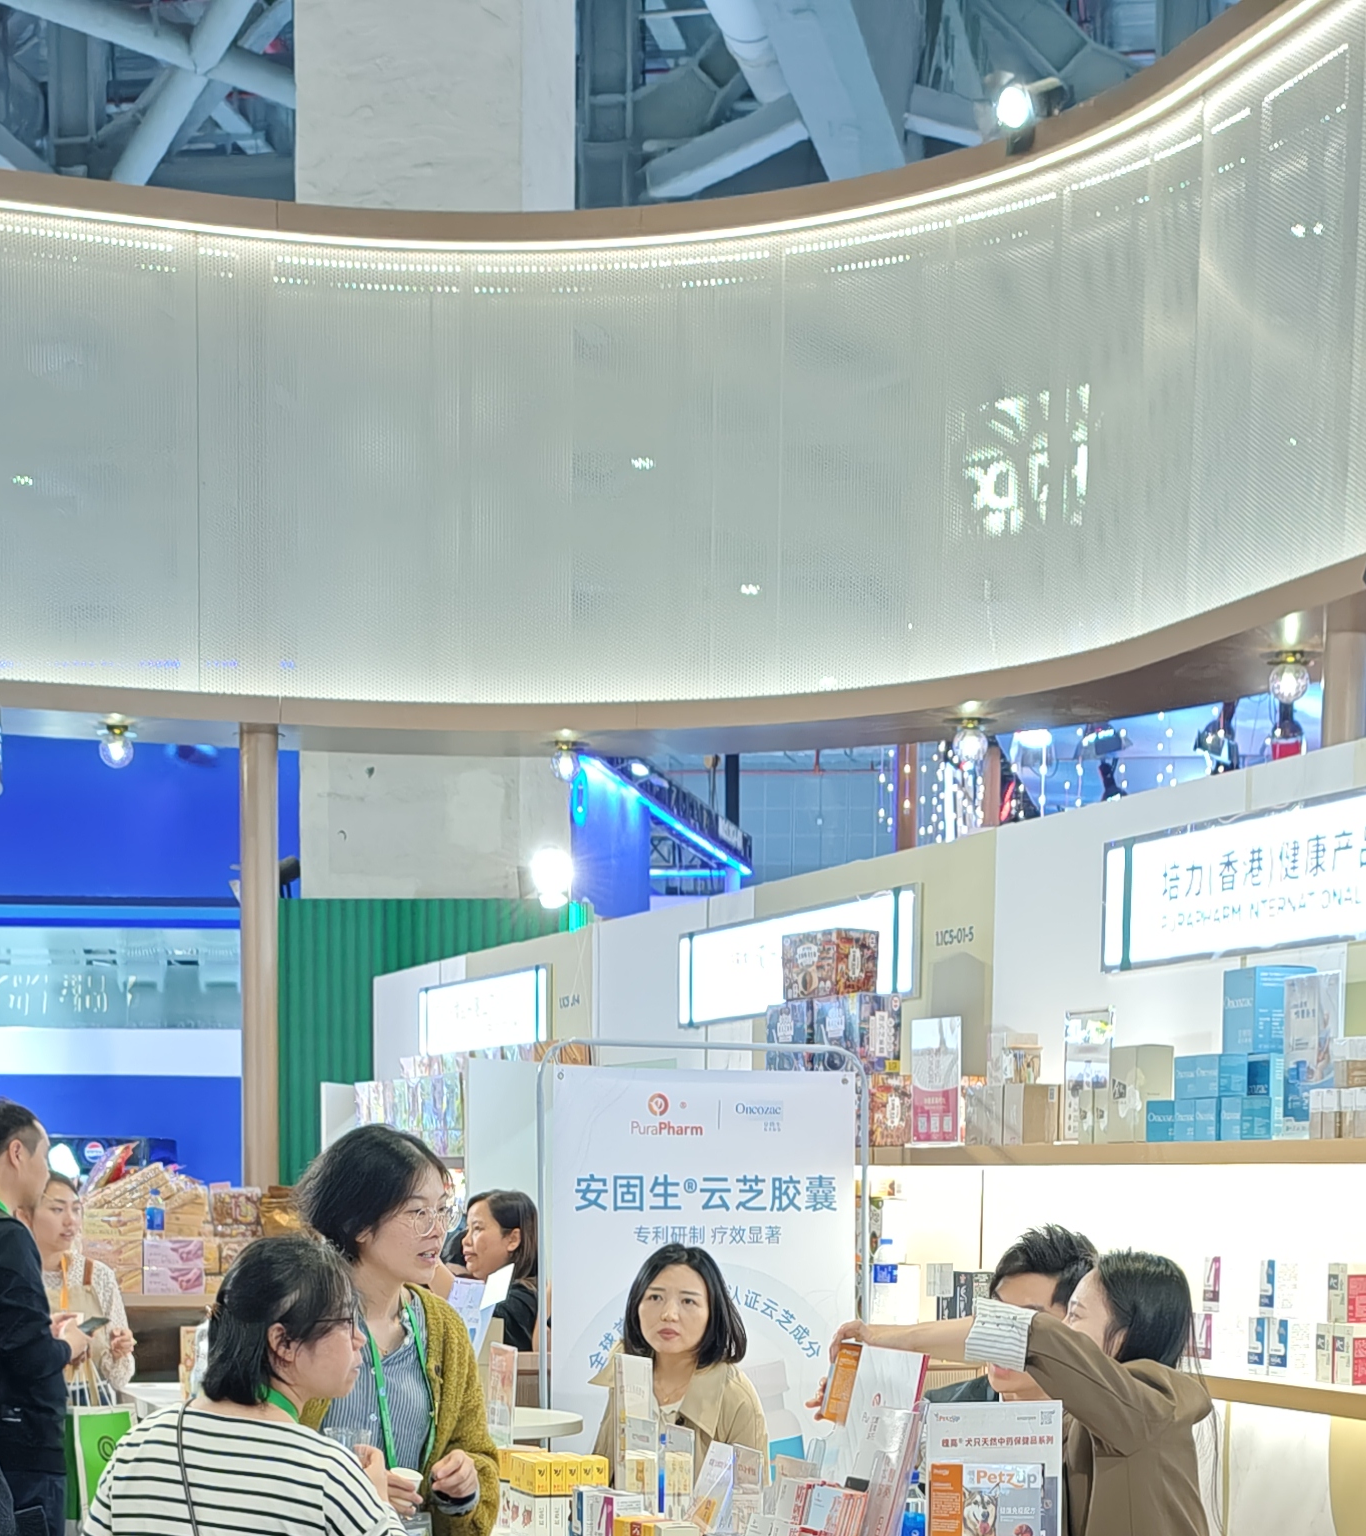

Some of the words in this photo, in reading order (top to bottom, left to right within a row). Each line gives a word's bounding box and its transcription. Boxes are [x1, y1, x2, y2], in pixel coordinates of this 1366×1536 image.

[735, 1102, 782, 1115] Oncozac
[630, 1120, 703, 1137] PuraPharm
[574, 1173, 838, 1213] 安固生®云芝胶囊
[633, 1224, 705, 1245] 专利研制
[710, 1224, 783, 1245] 疗效显著
